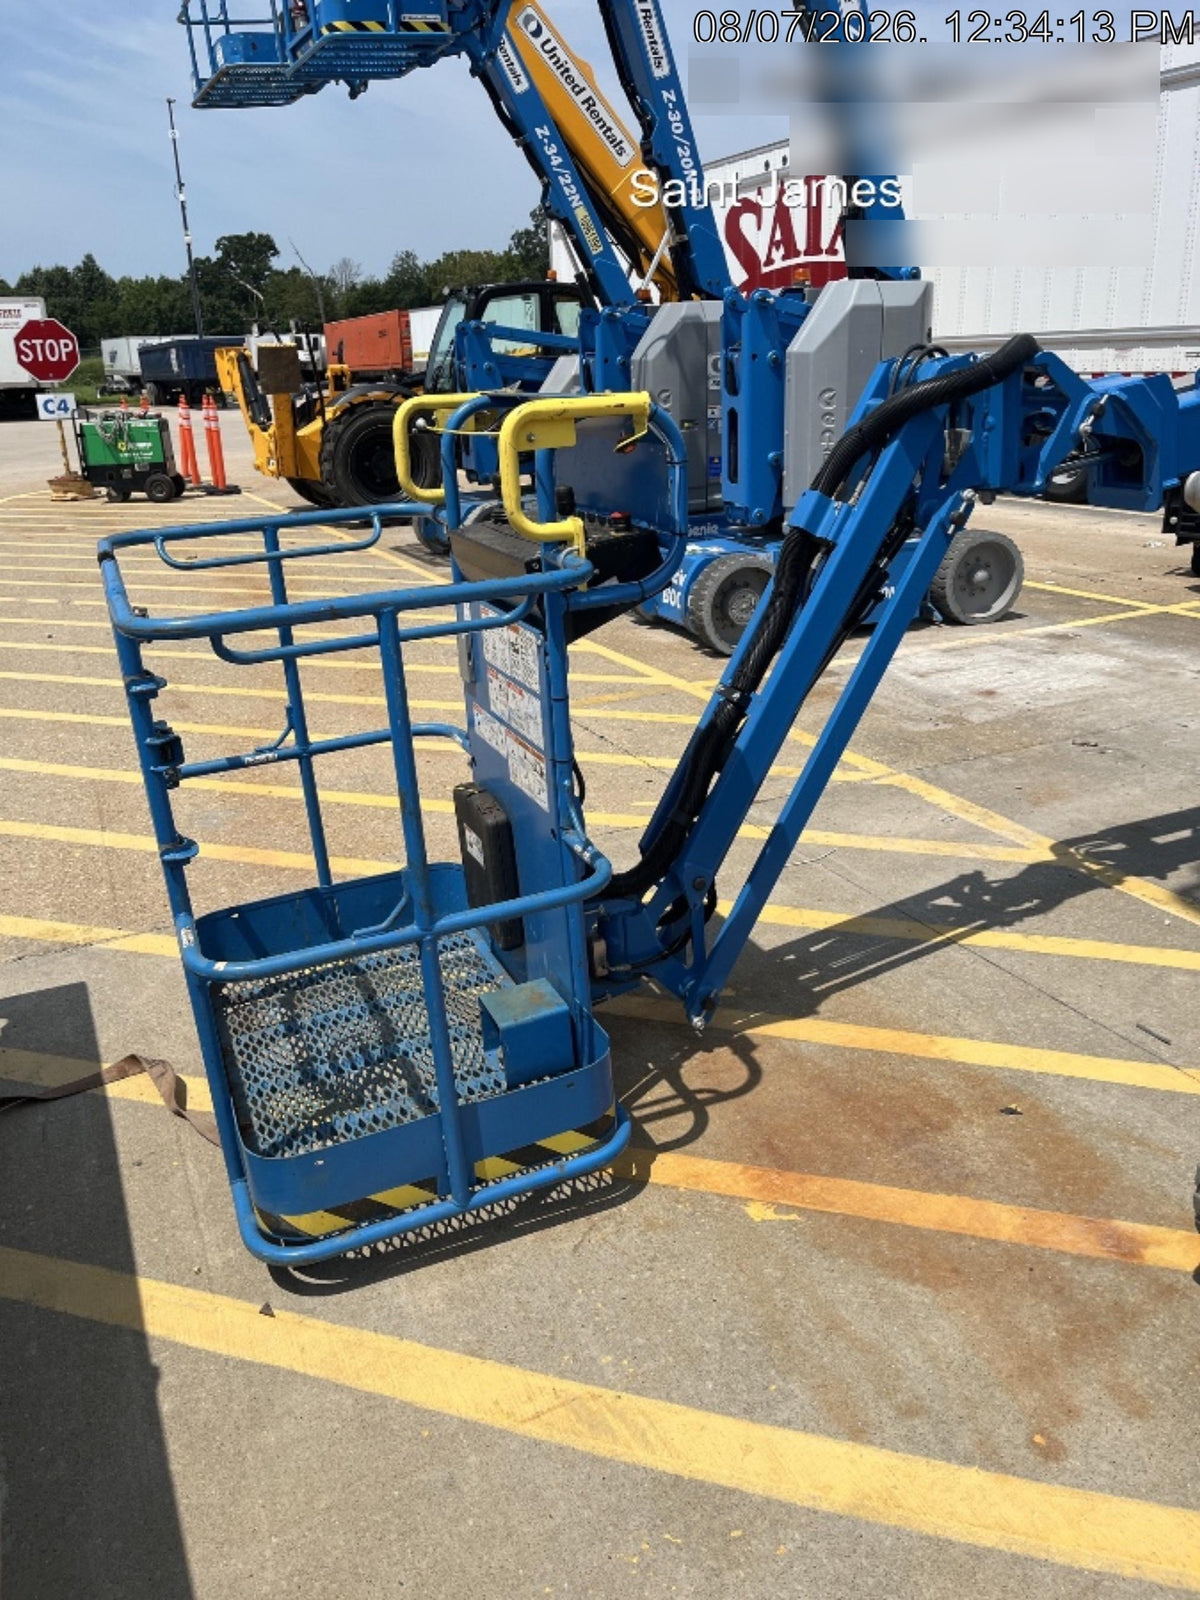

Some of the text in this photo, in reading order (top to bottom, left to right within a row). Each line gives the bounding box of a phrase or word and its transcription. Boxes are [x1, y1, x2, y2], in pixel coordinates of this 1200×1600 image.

[640, 8, 663, 71] Rentals
[540, 38, 627, 157] United Rentals
[534, 125, 584, 208] Z-34/22N
[19, 338, 73, 362] STOP
[42, 398, 70, 415] C4
